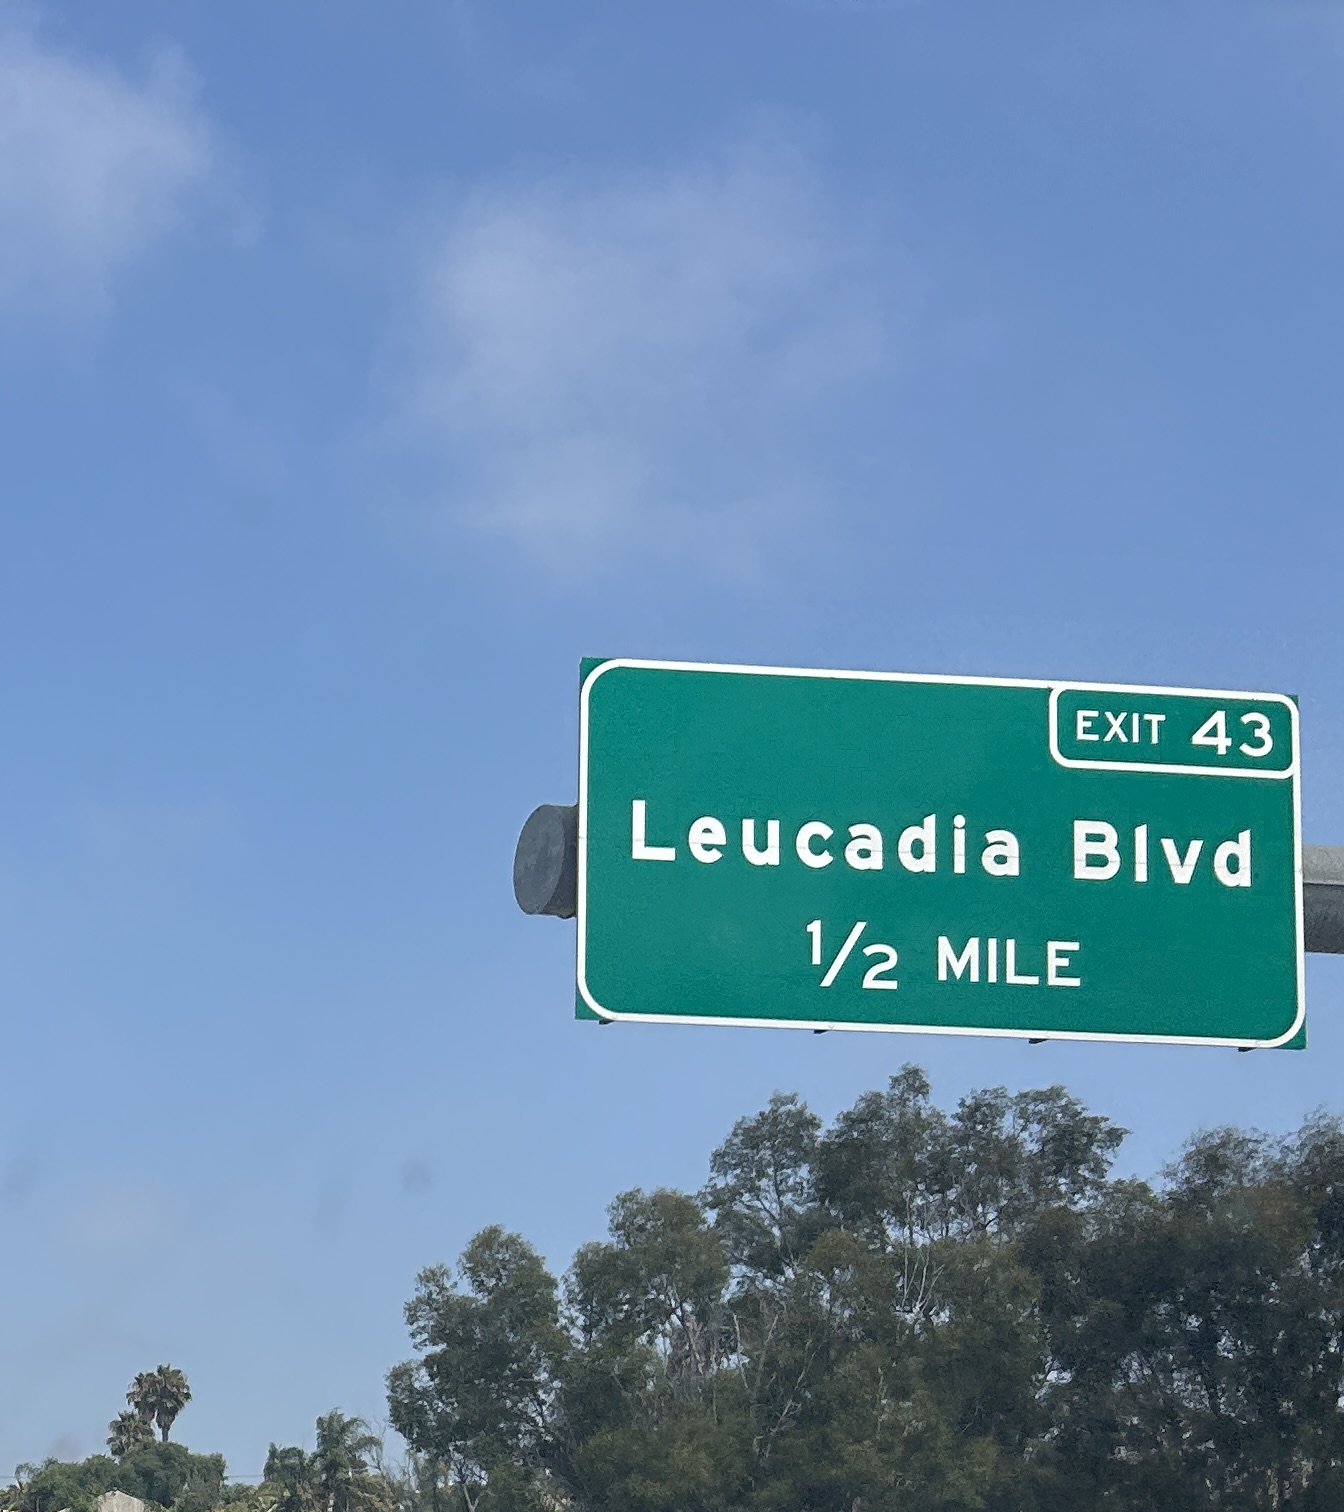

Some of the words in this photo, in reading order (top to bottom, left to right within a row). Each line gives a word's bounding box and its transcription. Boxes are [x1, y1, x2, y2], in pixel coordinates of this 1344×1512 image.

[1076, 709, 1166, 745] EXIT
[1191, 710, 1274, 758] 43
[631, 799, 1021, 878] Leucadia
[1073, 819, 1253, 888] Blvd
[937, 935, 1081, 988] MILE
